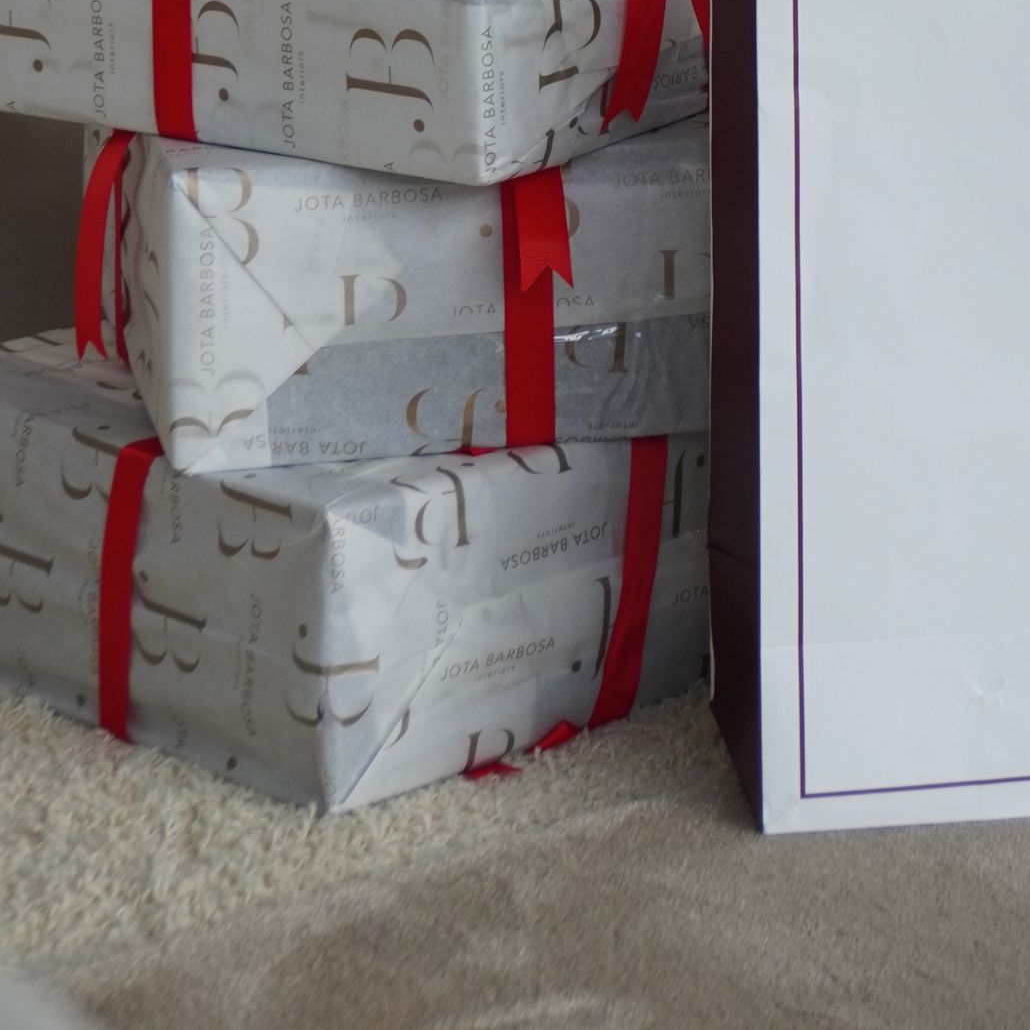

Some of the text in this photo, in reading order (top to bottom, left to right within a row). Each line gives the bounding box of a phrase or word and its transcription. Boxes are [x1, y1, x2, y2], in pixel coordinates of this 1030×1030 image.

[93, 70, 107, 119] JOTA
[280, 1, 296, 149] JOTA BARBOSA
[480, 25, 496, 119] BARBOSA
[294, 186, 444, 212] JOTA BARBOSA
[199, 225, 216, 377] JOTA BARBOSA
[318, 440, 369, 457] JOTA
[500, 521, 609, 572] JOTA BARBOSA
[434, 599, 450, 648] JOTA
[440, 659, 480, 682] JOTA
[485, 636, 556, 667] BARBOSA
